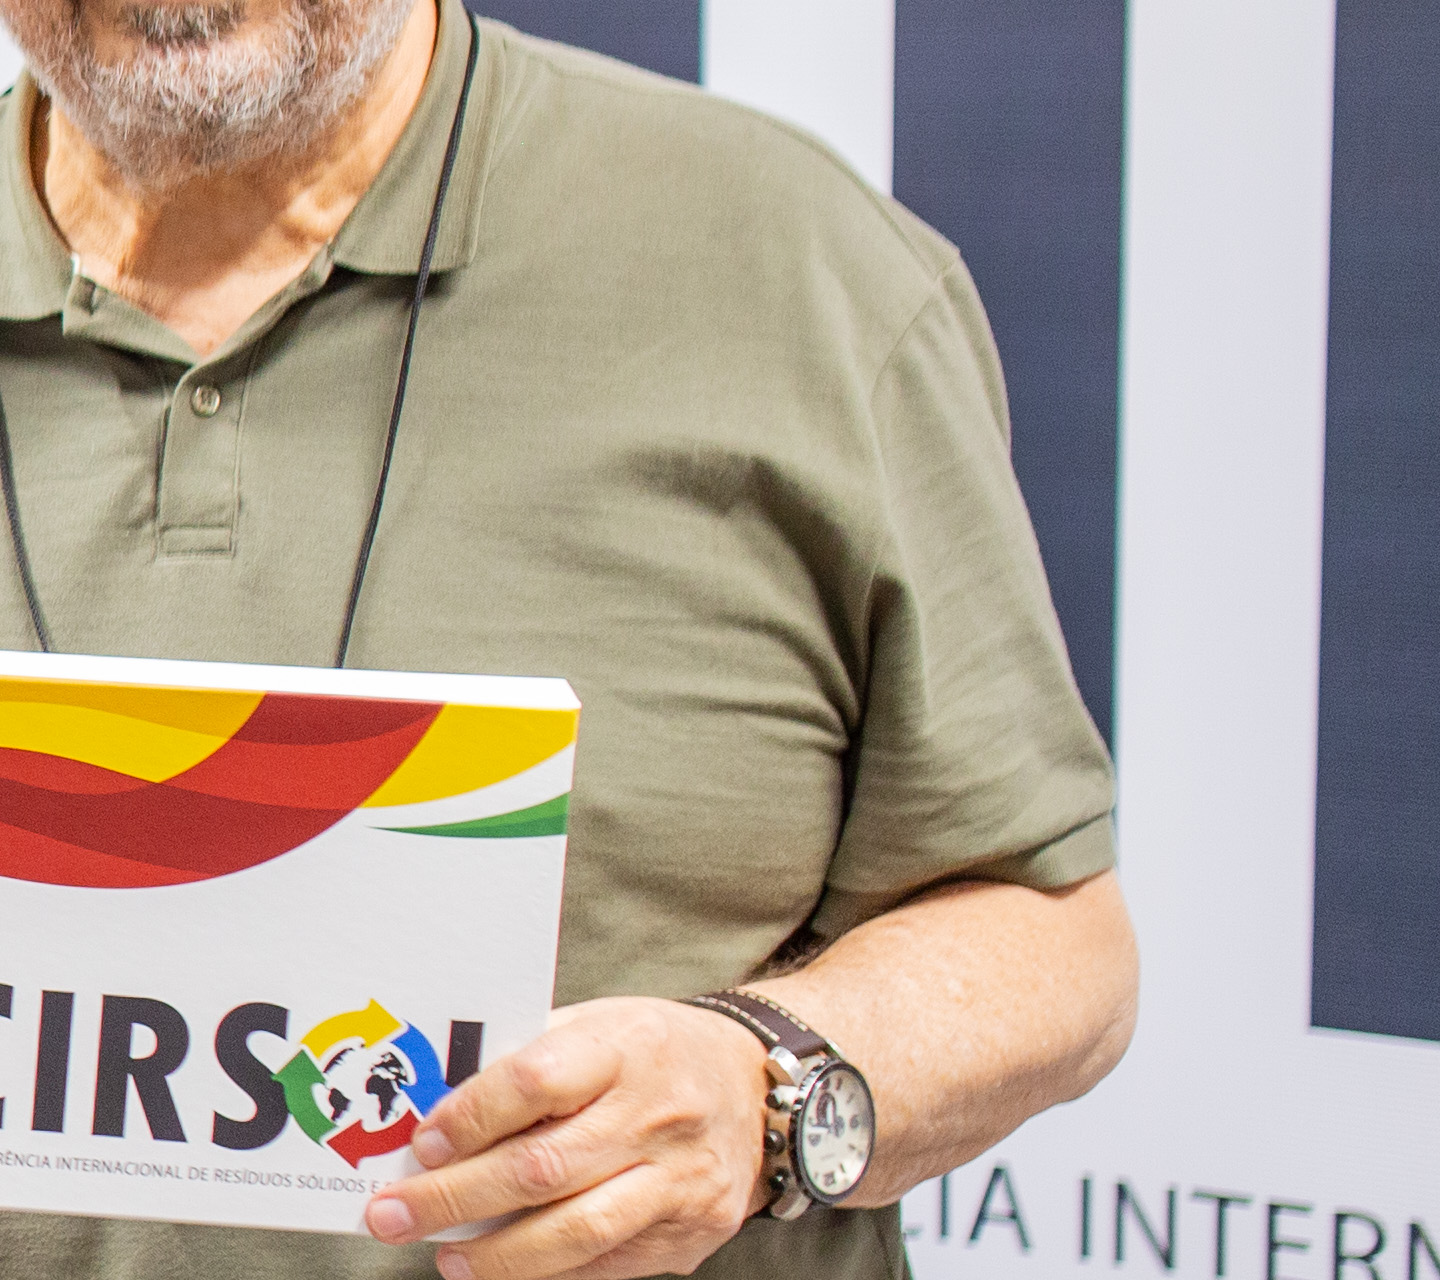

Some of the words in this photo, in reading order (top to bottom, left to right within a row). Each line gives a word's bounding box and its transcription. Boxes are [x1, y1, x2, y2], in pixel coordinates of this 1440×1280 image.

[55, 1155, 182, 1180] INTERNACIONAL
[187, 1166, 209, 1181] DE
[214, 1168, 291, 1188] RESÍDUOS
[296, 1173, 366, 1194] SÓLIDOS
[903, 1166, 1034, 1255] IA
